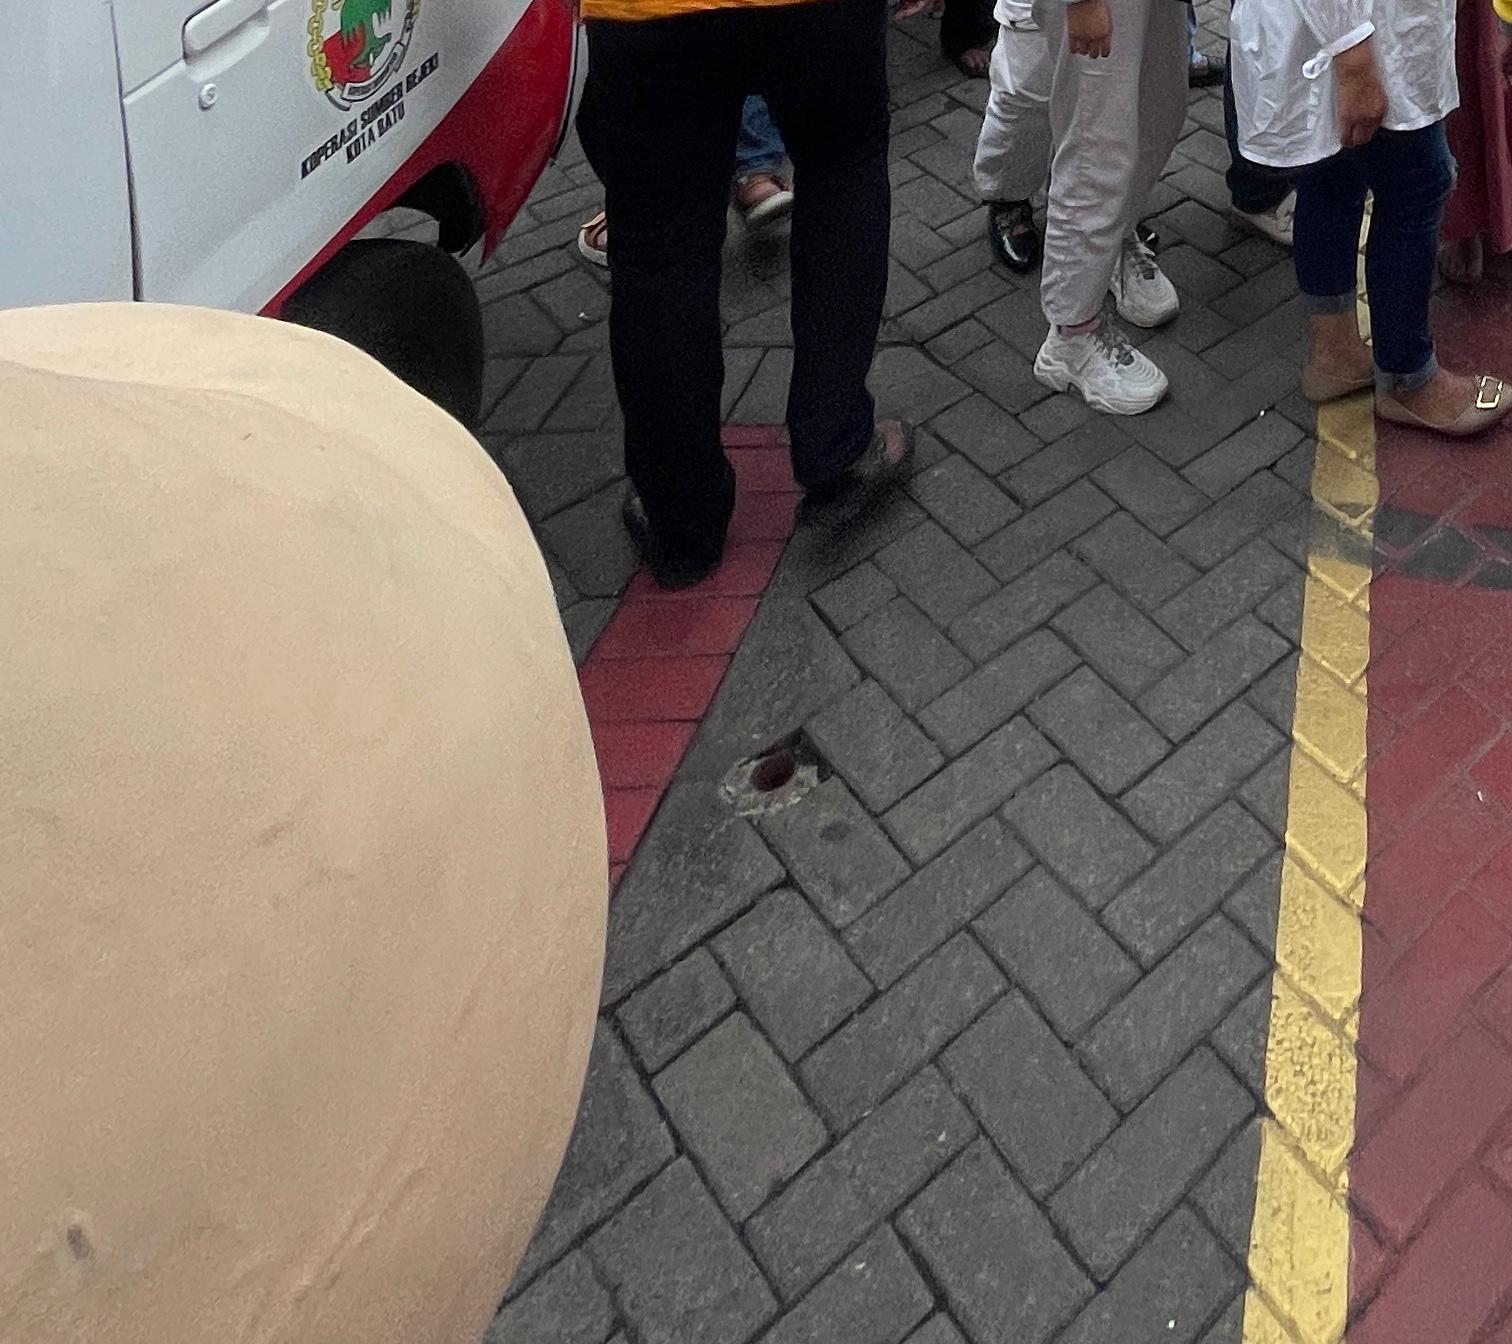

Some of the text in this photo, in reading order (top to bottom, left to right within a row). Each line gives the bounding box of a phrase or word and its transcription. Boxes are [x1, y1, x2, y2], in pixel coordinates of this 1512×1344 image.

[300, 118, 358, 180] KOPERASI
[346, 100, 405, 164] KOTA BATU
